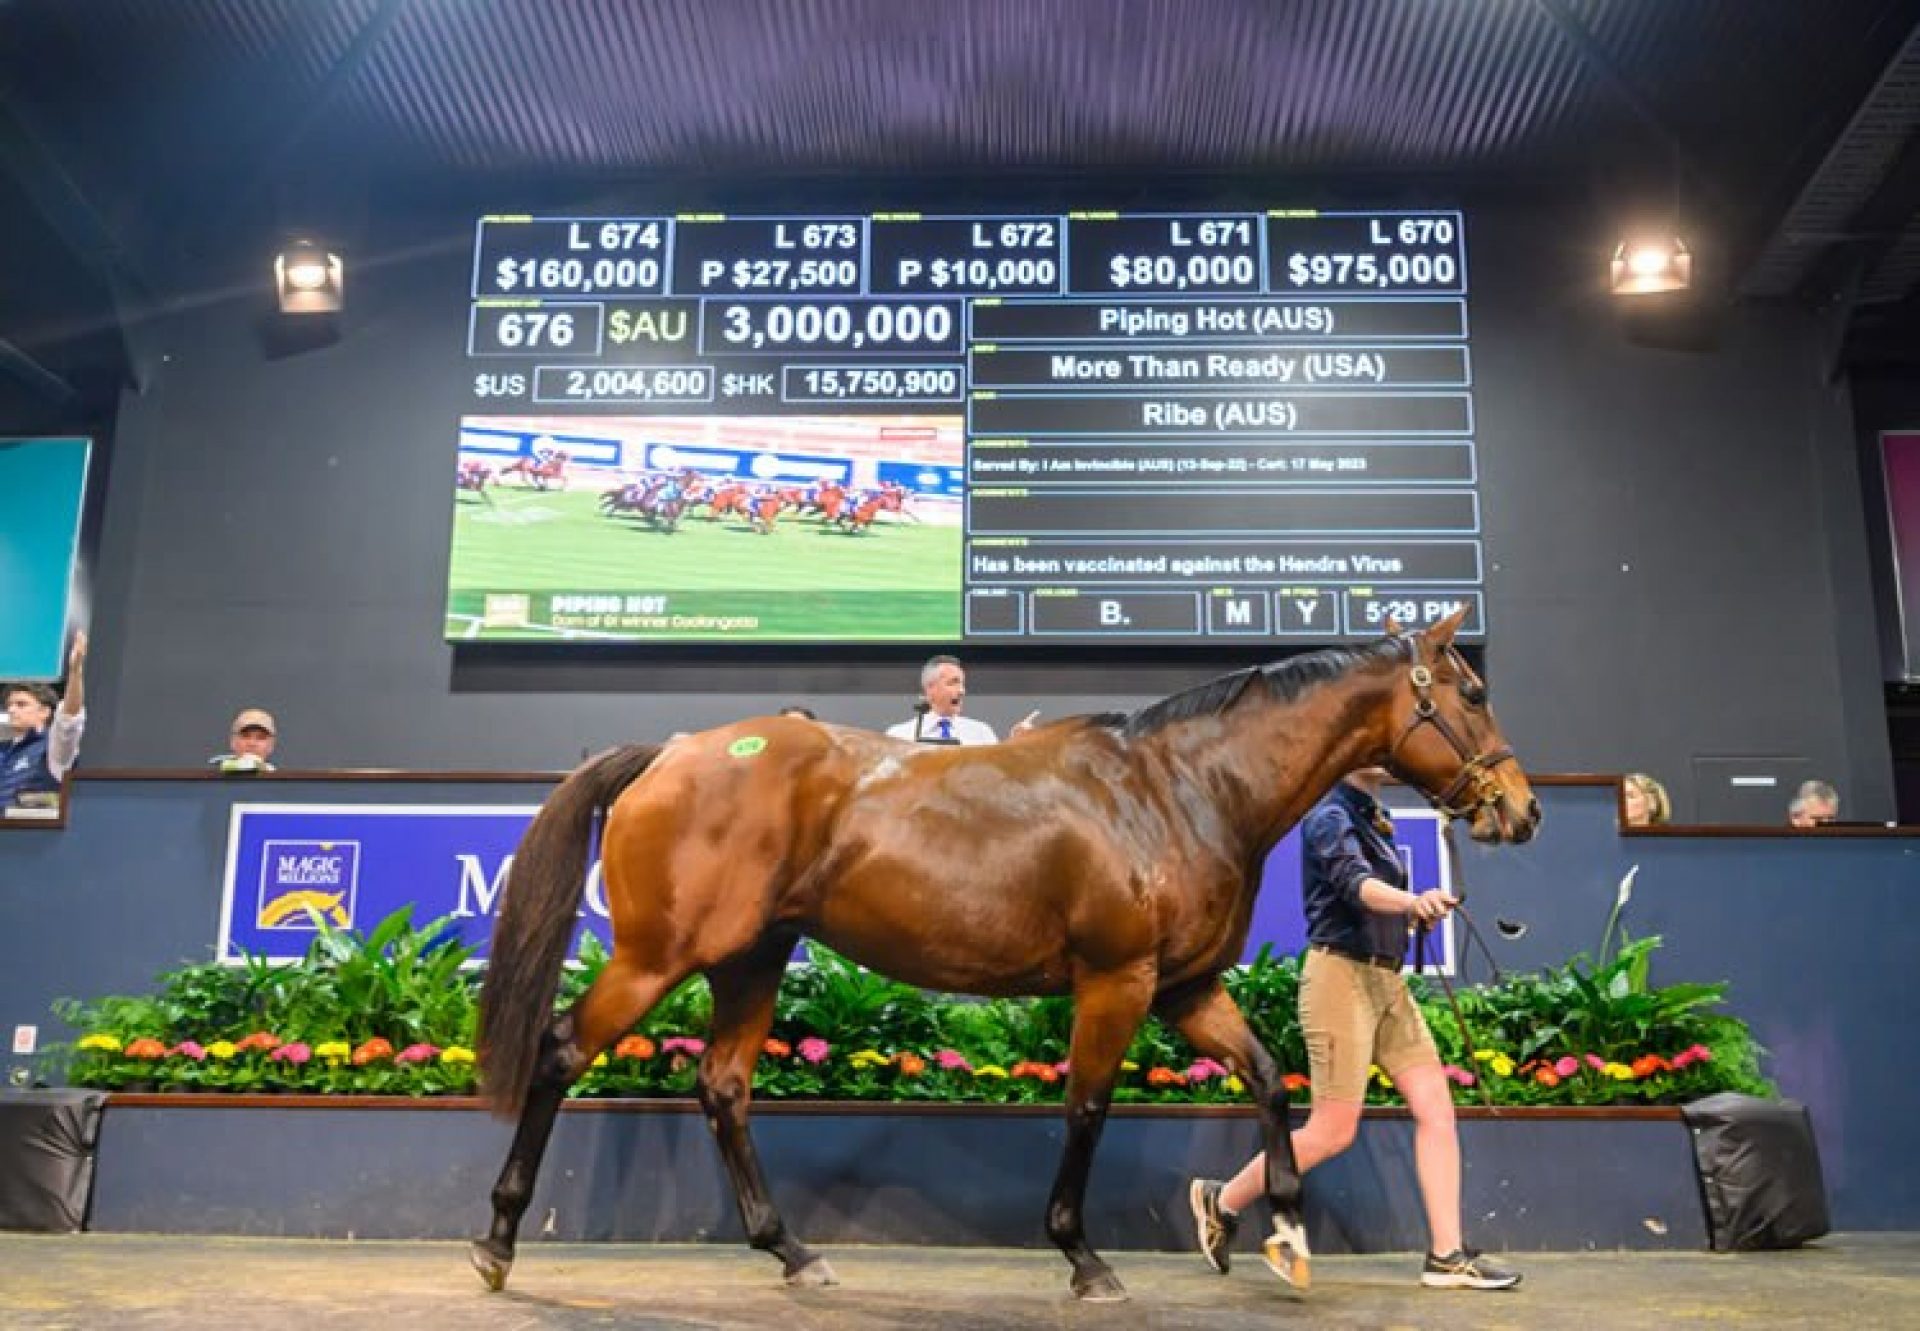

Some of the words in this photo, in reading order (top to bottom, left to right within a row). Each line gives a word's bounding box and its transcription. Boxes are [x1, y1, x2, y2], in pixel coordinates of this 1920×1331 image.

[569, 223, 591, 249] L
[599, 223, 660, 249] 674
[776, 225, 795, 249] L
[804, 225, 855, 248] 673
[973, 223, 992, 247] L
[1001, 223, 1053, 246] 672
[1171, 222, 1192, 247] L
[1198, 222, 1249, 246] 671
[1371, 220, 1392, 244] L
[1398, 220, 1452, 243] 670
[497, 258, 658, 292] $160,000
[701, 261, 724, 286] P
[732, 259, 855, 289] $27,500
[899, 261, 922, 284] P
[931, 259, 1055, 289] $10,000
[1111, 256, 1252, 289] $80,000
[1288, 253, 1454, 287] $975,000
[499, 313, 573, 346] 676
[608, 308, 687, 344] $AU
[724, 305, 950, 348] 3,000,000
[1100, 307, 1188, 335] Piping
[1198, 307, 1247, 330] Hot
[1252, 307, 1335, 335] (AUS)
[1052, 356, 1121, 378] More
[1129, 356, 1198, 377] Than
[1208, 355, 1297, 382] Ready
[1304, 355, 1385, 382] (USA)
[474, 374, 525, 397] $US
[567, 370, 705, 399] 2,004,600
[722, 373, 773, 397] $HK
[804, 370, 956, 398] 15,750,900
[1144, 402, 1206, 425] Ribe
[1216, 402, 1296, 430] (AUS)
[973, 556, 1009, 572] Has
[1014, 556, 1060, 573] been
[1065, 556, 1166, 572] vaccinated
[1171, 556, 1241, 576] against
[1244, 556, 1275, 571] the
[1351, 555, 1402, 571] Virus
[627, 595, 667, 614] HOT
[1101, 601, 1130, 625] B.
[1226, 601, 1250, 624] M
[1296, 599, 1318, 624] Y
[279, 855, 342, 870] MAGIC
